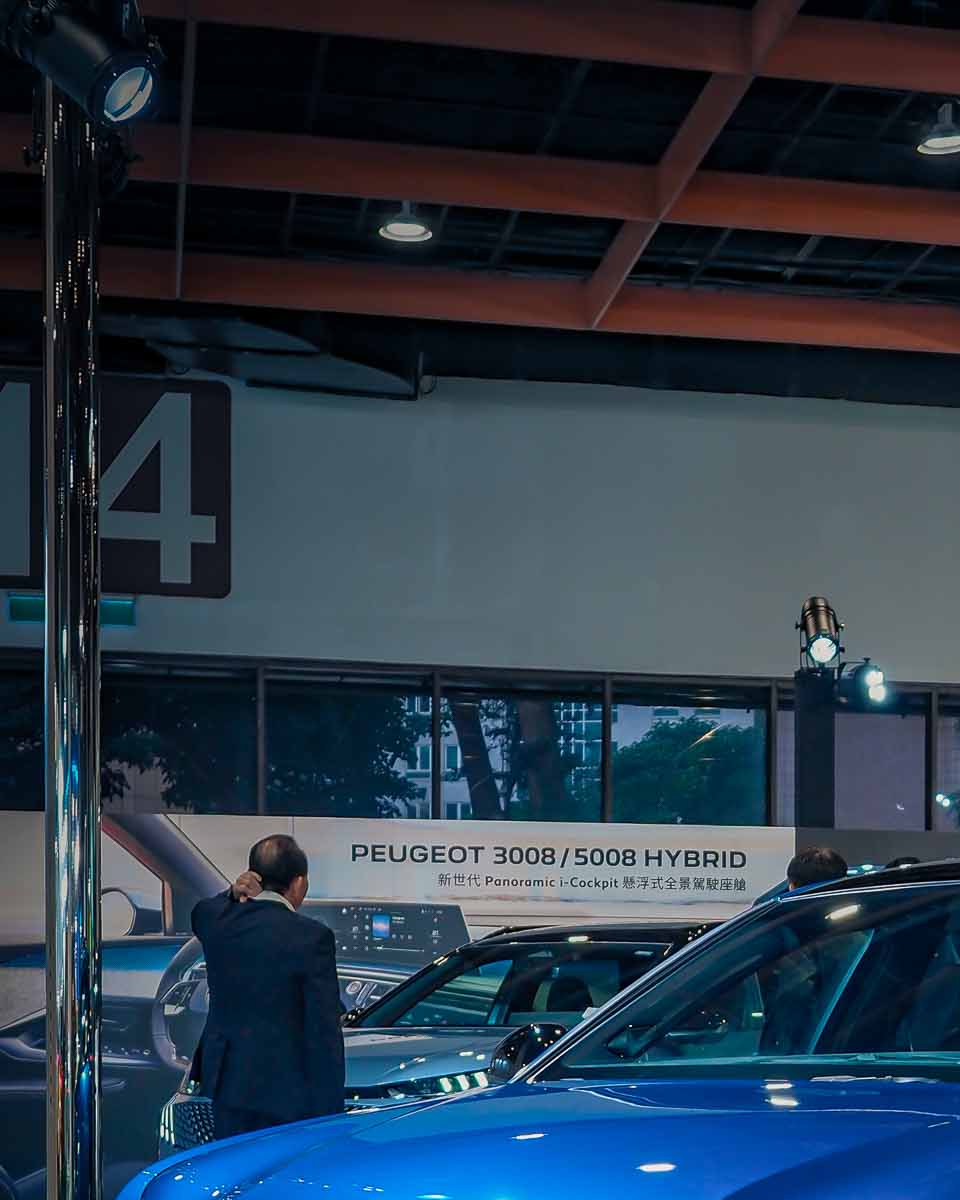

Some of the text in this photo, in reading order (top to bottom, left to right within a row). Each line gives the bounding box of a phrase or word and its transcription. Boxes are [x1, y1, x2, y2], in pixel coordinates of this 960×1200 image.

[351, 844, 485, 864] PEUGEOT
[645, 849, 747, 869] HYBRID
[438, 872, 747, 892] 新世代 Panoramic i-Cockpit 懸浮式全景駕駛座艙
